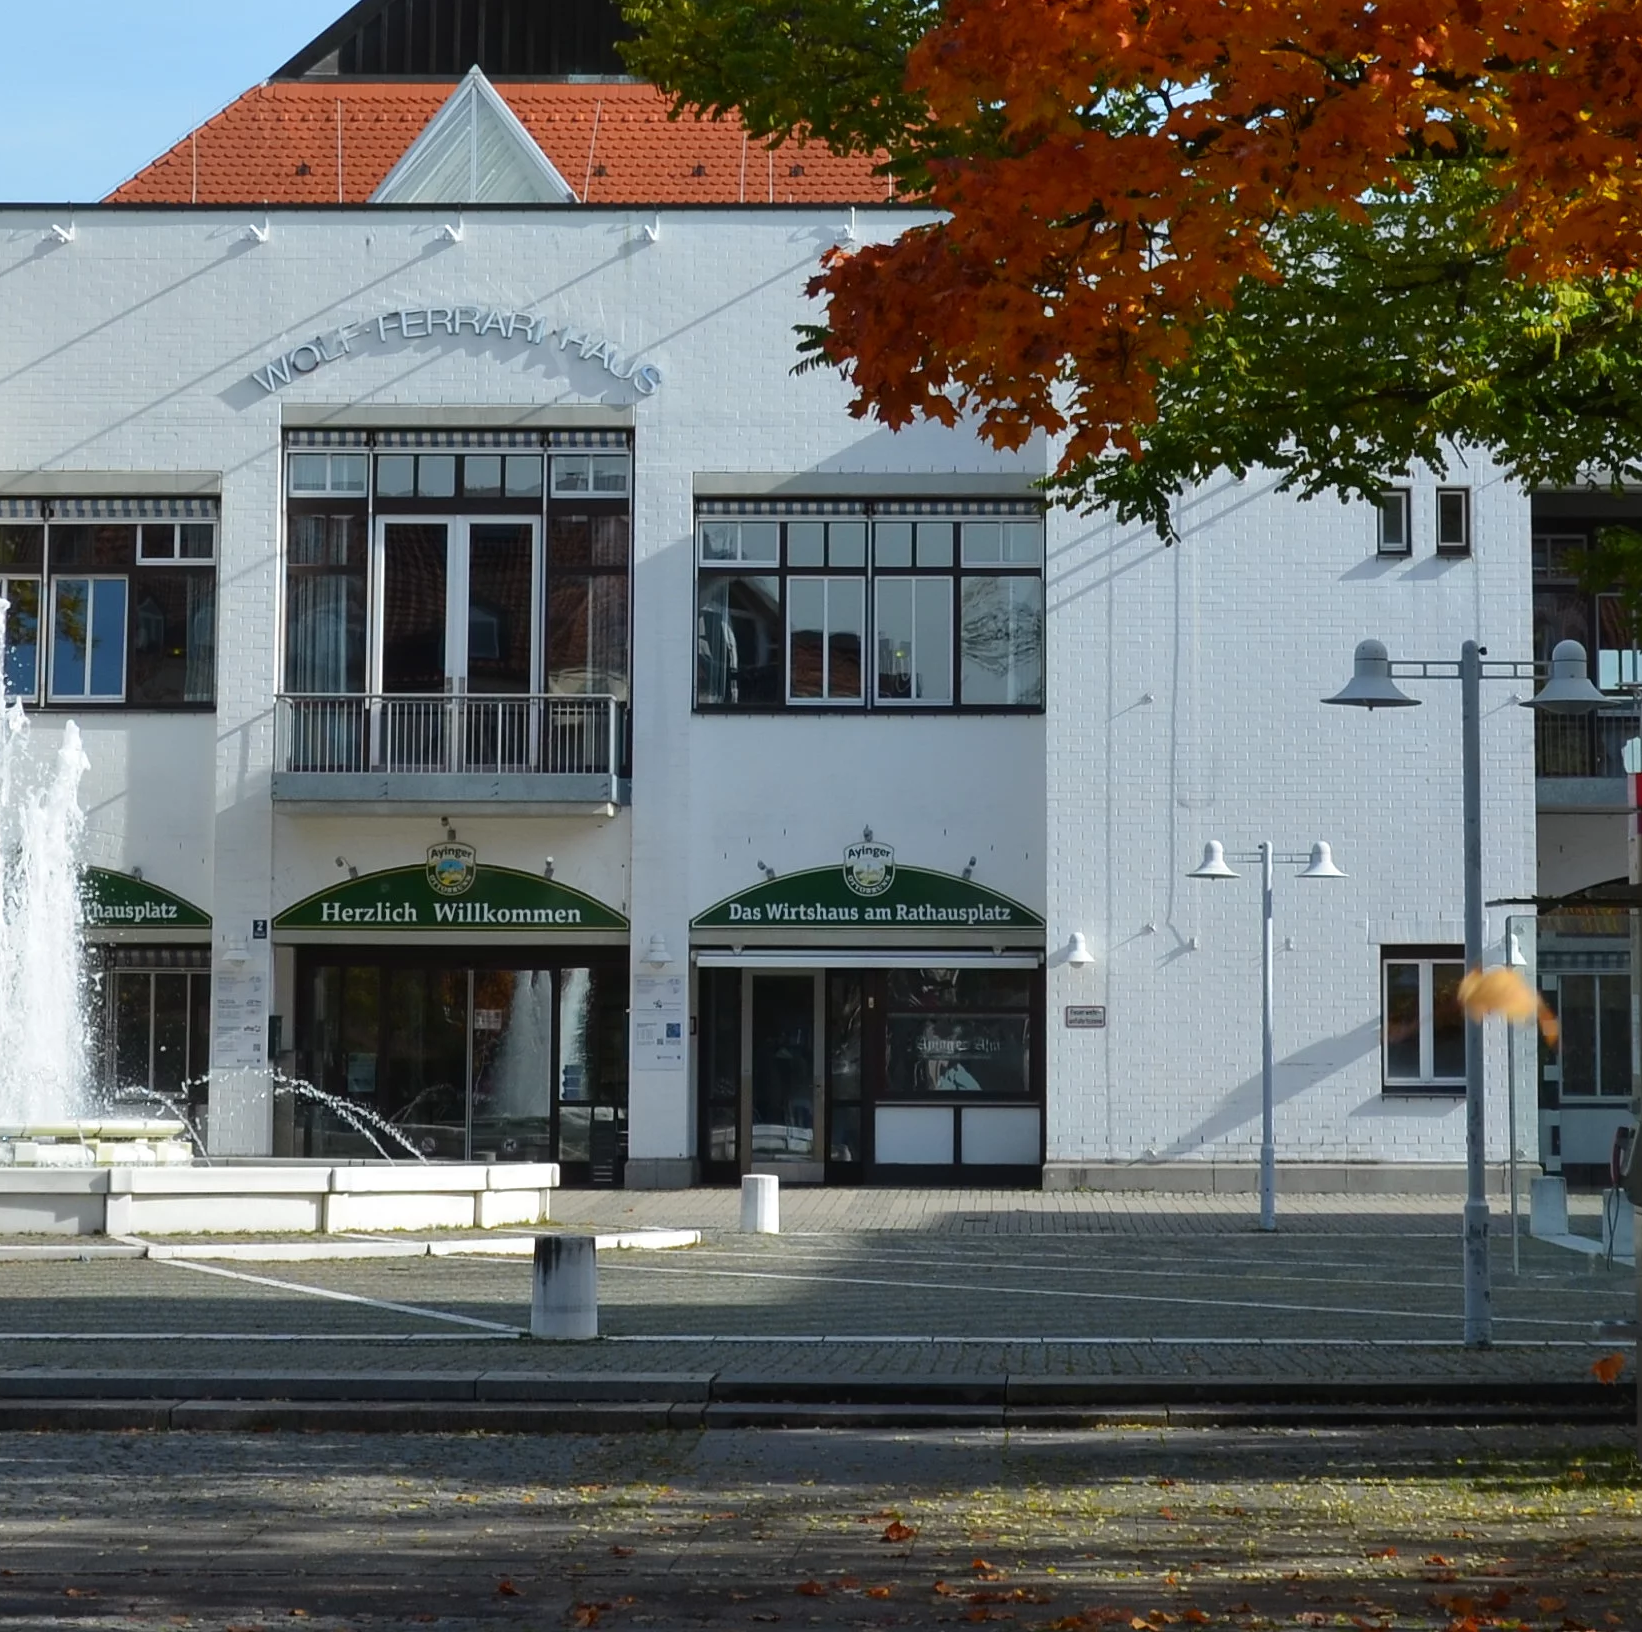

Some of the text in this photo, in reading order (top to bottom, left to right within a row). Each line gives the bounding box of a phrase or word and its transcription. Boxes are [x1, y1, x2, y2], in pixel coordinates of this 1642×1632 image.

[252, 306, 662, 396] WOLF FERRARI HAUS
[431, 845, 473, 859] Ayinger
[847, 845, 892, 859] Ayinger
[321, 902, 582, 924] Herzlich Willkommen
[728, 902, 1012, 924] Das Wirtshaus am Rathausplatz
[256, 921, 264, 931] 2
